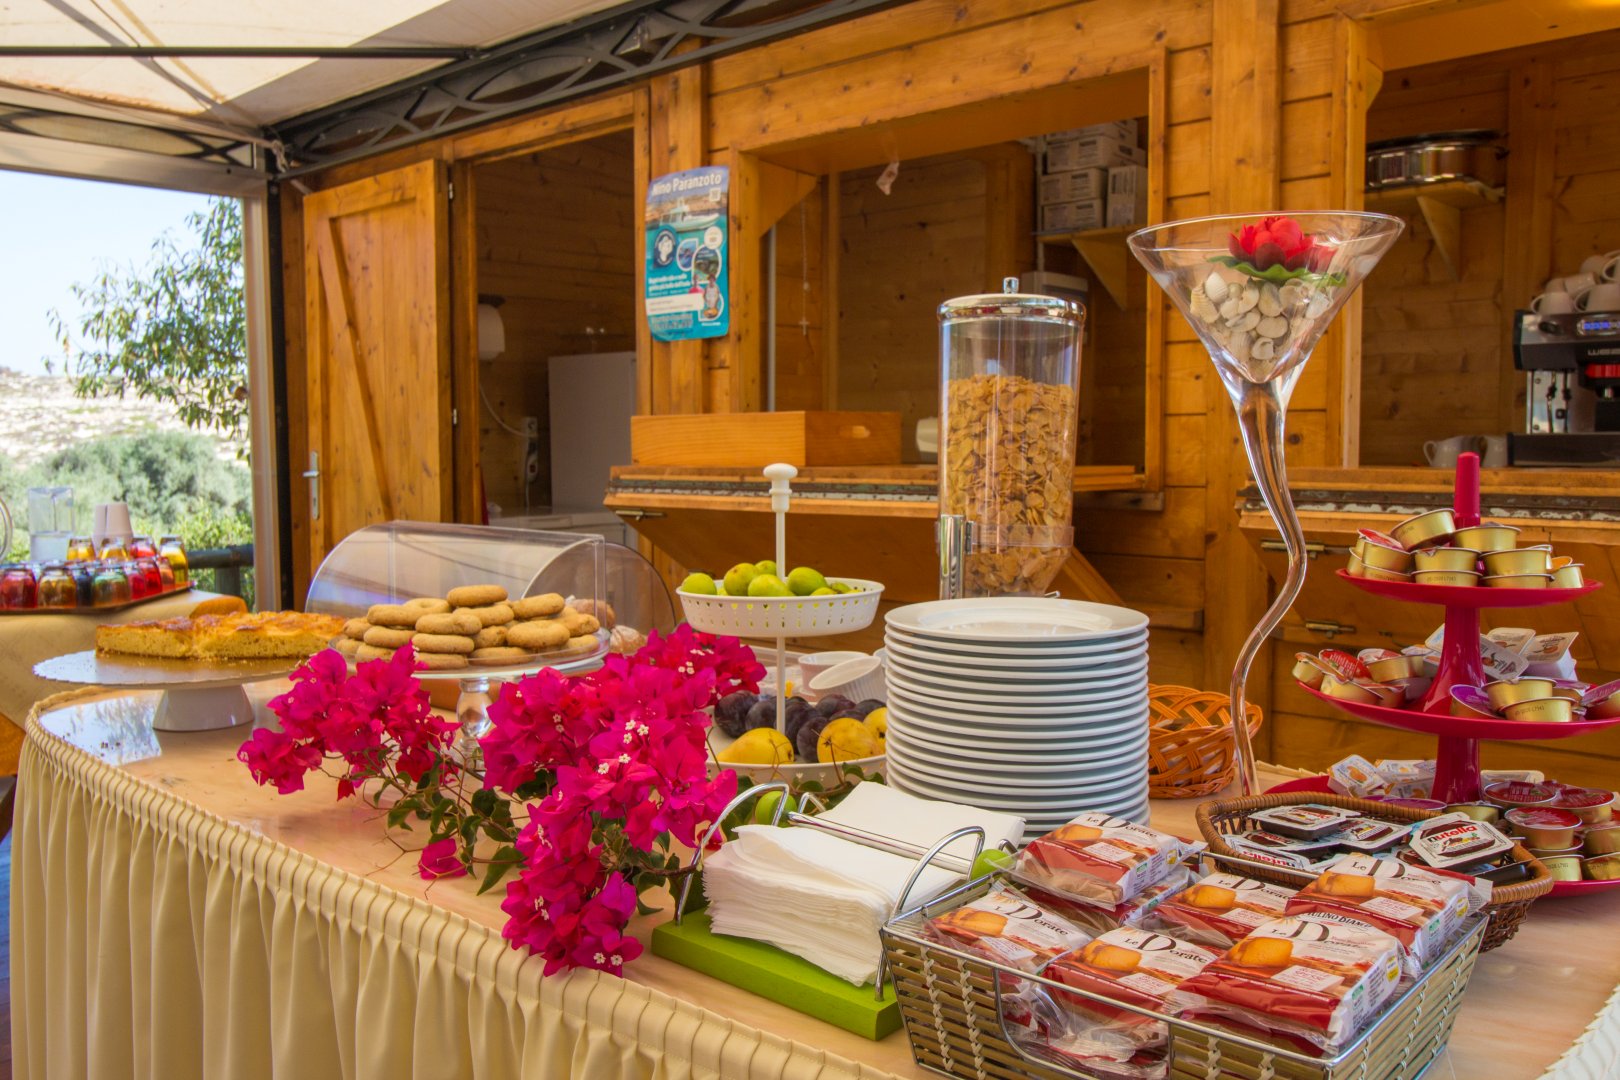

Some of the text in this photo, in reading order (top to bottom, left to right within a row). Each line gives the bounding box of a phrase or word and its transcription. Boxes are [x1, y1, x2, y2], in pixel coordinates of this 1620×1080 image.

[1099, 816, 1158, 839] Dorate
[1427, 825, 1478, 843] nutella
[1004, 904, 1068, 936] Dorate
[1137, 934, 1208, 964] Dorate
